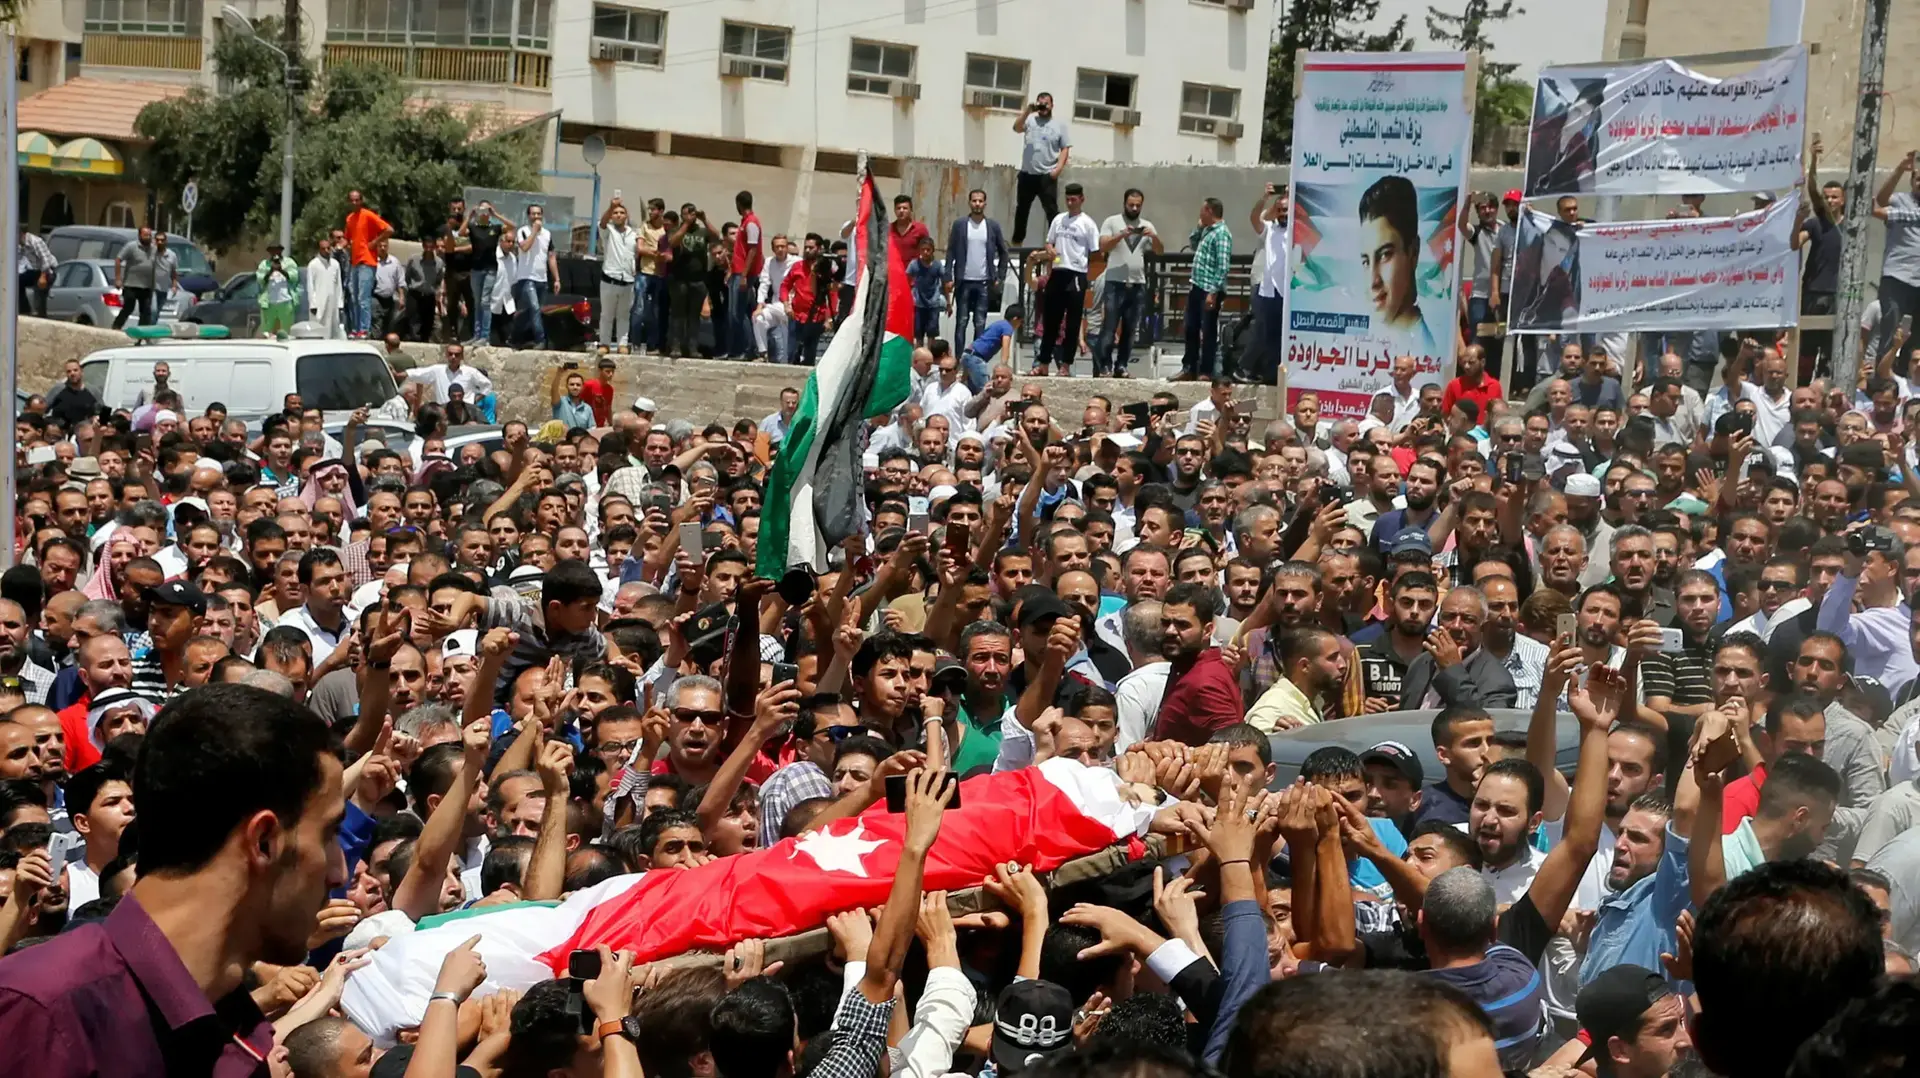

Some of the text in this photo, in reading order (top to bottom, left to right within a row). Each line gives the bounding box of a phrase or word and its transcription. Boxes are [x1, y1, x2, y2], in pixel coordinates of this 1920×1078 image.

[1340, 116, 1422, 148] يزف الشعب الفلسطيني
[1403, 153, 1437, 173] الداخل
[1438, 153, 1452, 177] في
[1292, 312, 1315, 329] البطل
[1288, 334, 1353, 372] الجواودة
[1016, 1013, 1057, 1047] 88
